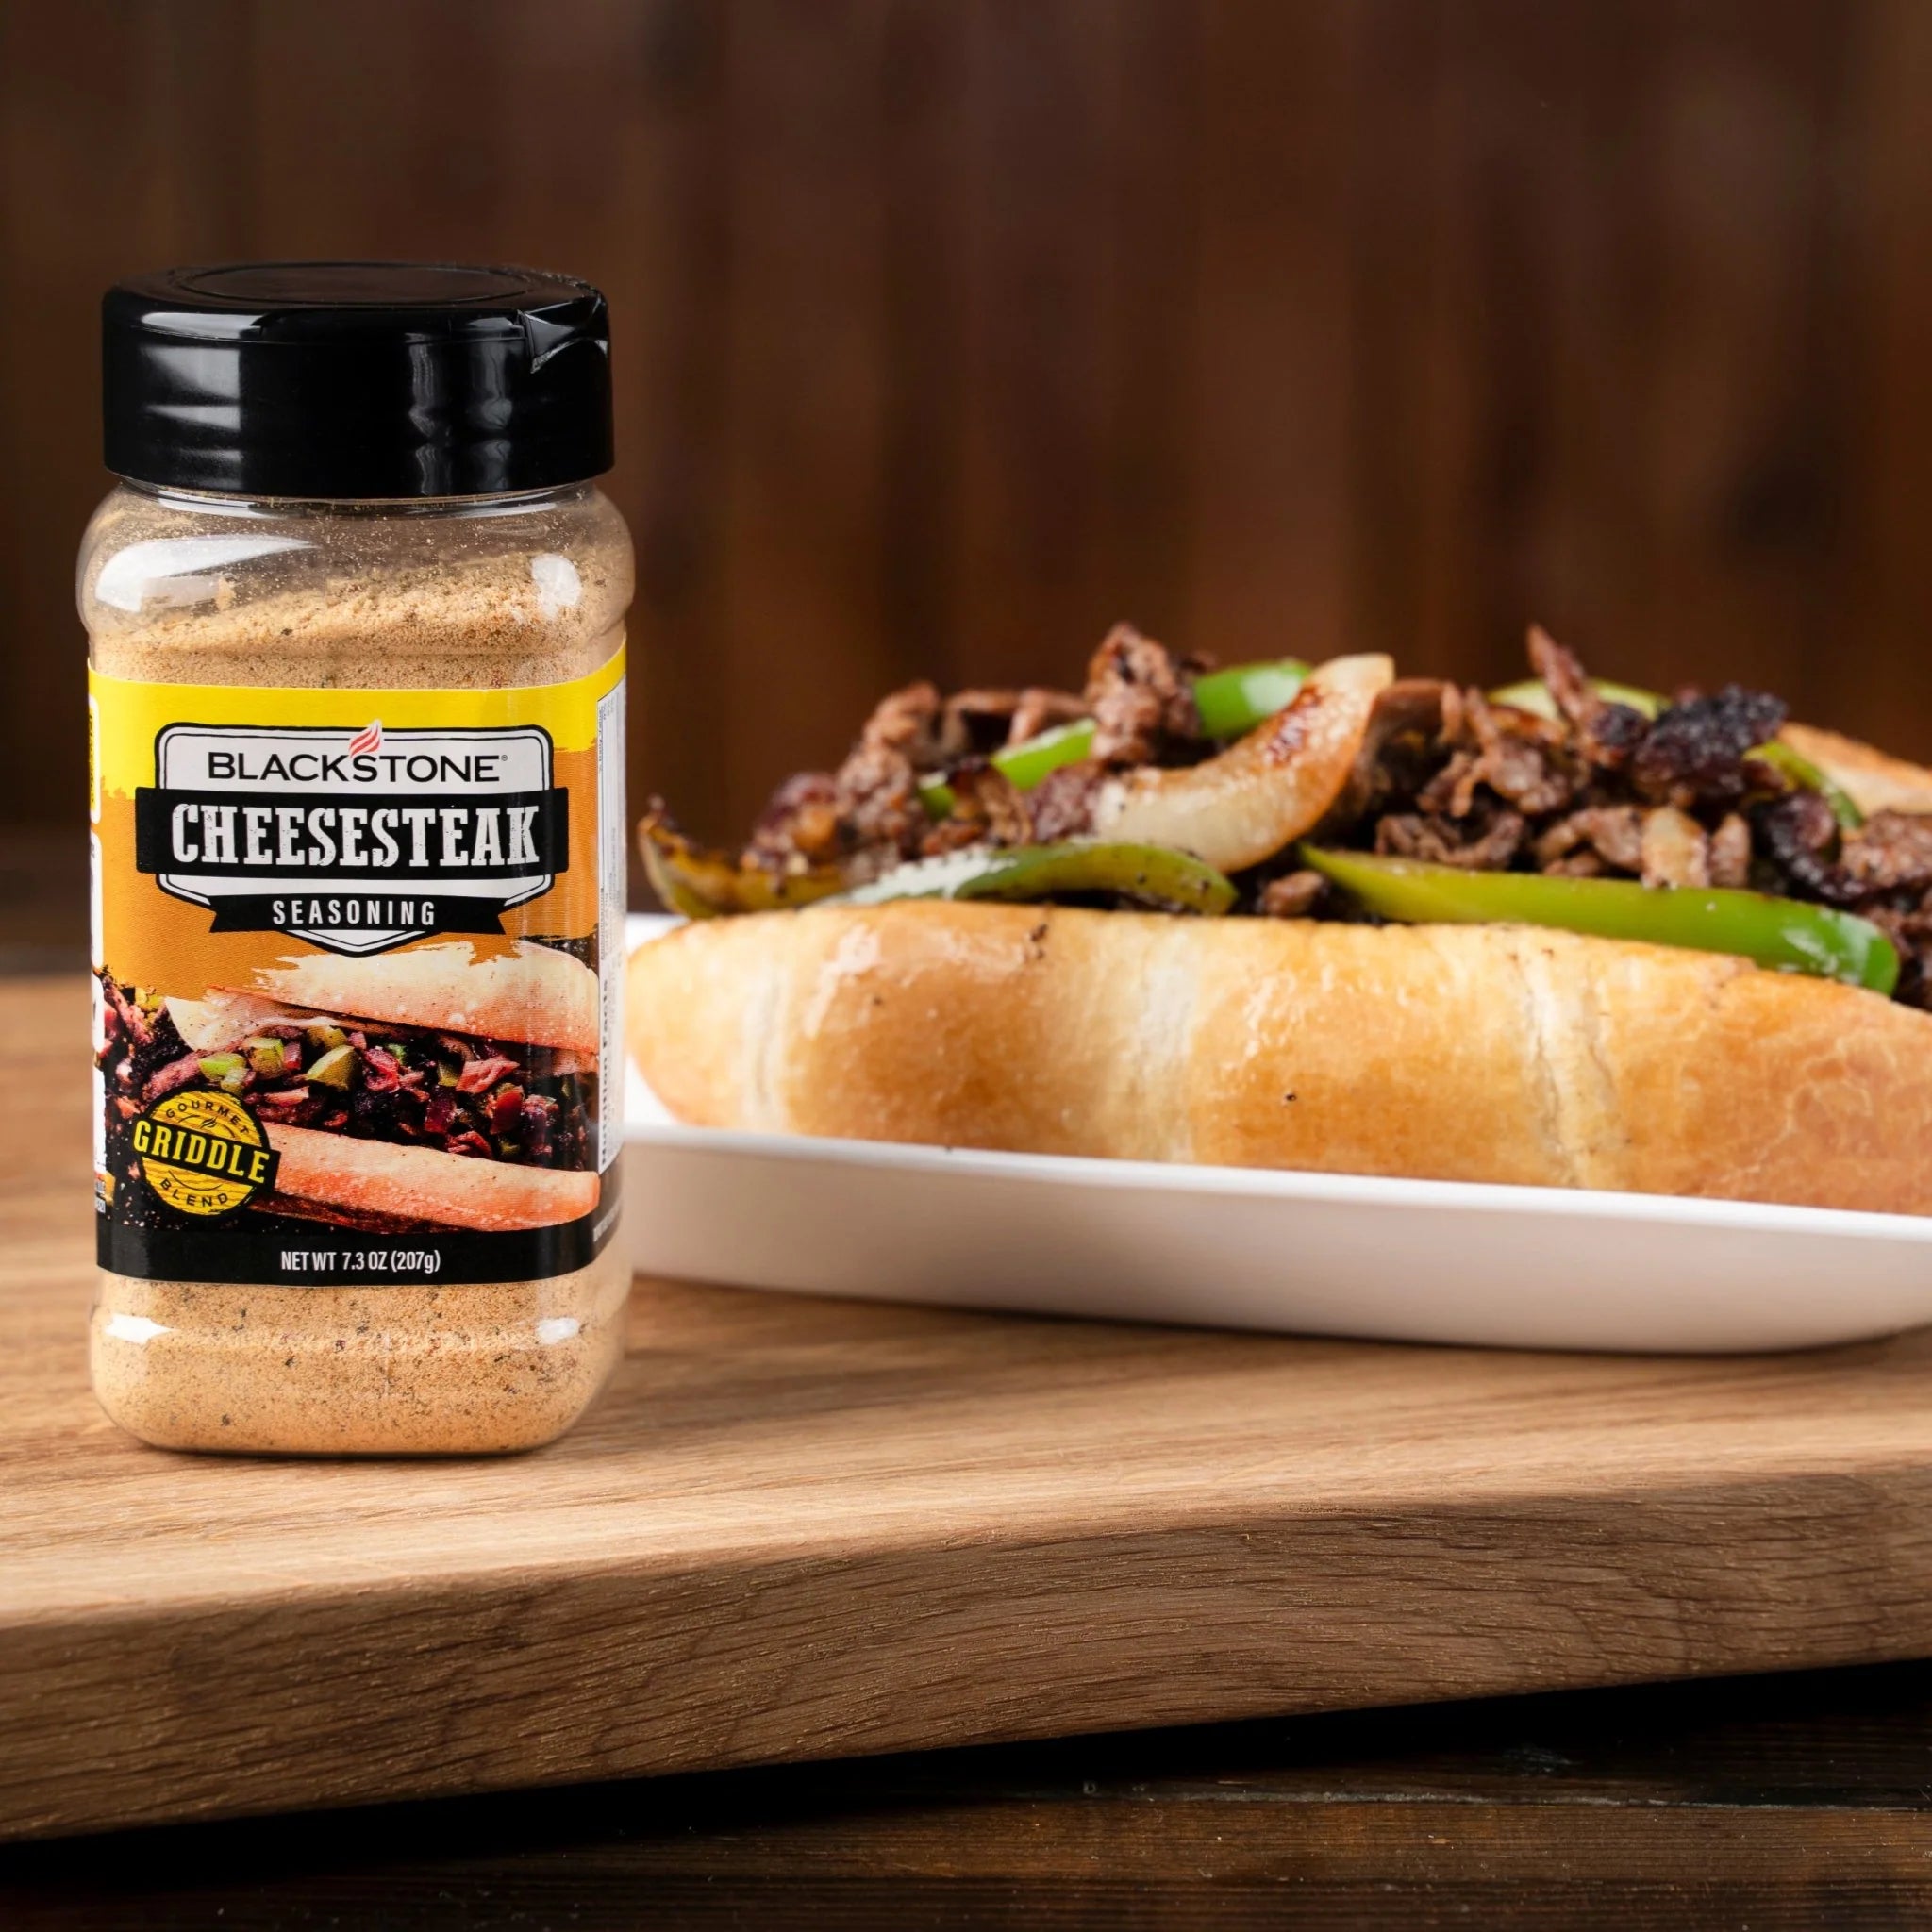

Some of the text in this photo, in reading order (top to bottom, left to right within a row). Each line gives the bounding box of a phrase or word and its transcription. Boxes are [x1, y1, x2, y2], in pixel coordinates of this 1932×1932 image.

[171, 803, 540, 868] CHEESESTEAK
[272, 899, 436, 927] SEASONING
[165, 1099, 250, 1135] GOURMET
[133, 1120, 270, 1184] GRIDDLE
[159, 1177, 229, 1208] BLEND
[281, 1249, 441, 1274] NET WT 7.3 OZ (207g)
